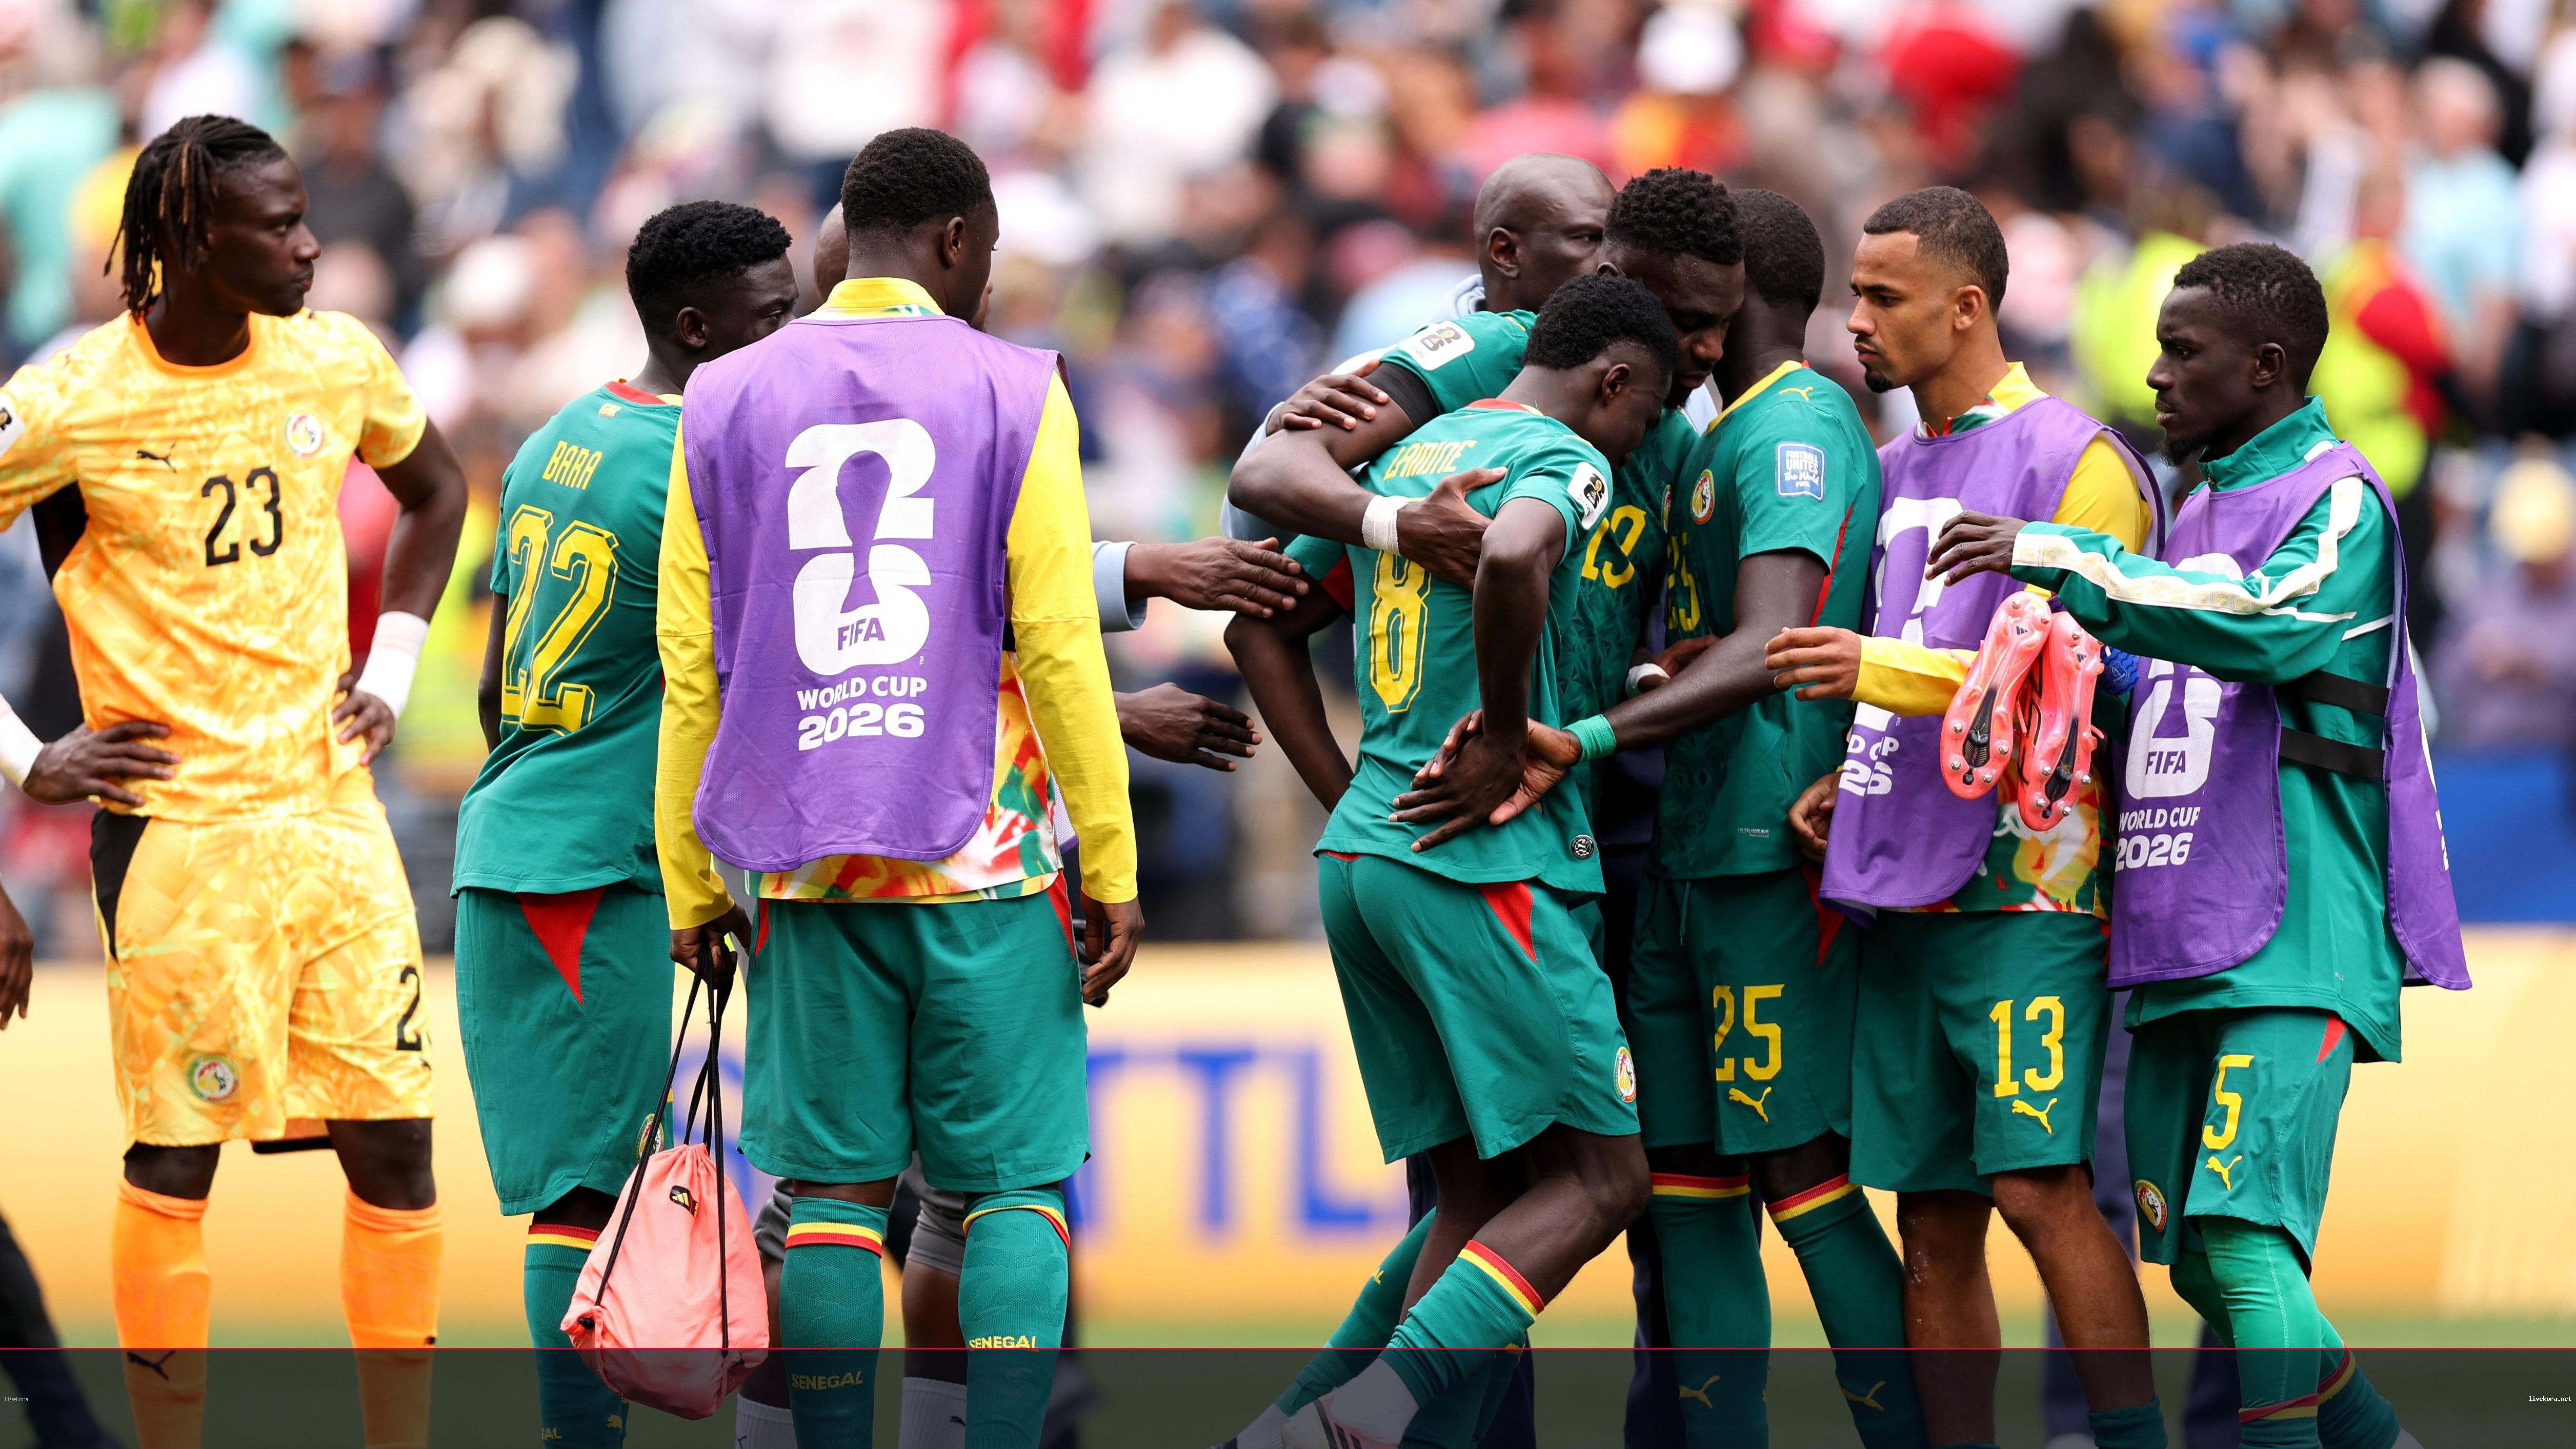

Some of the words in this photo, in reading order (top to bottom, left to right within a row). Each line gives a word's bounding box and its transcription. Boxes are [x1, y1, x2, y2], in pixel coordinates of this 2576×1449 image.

[542, 440, 603, 490] BARA
[1786, 450, 1818, 464] FOOTBALL
[1786, 458, 1818, 475] UNITES
[1784, 470, 1798, 481] the
[1799, 470, 1819, 486] World
[201, 466, 283, 567] 23
[501, 504, 620, 736] 22
[837, 617, 886, 651] FIFA
[1369, 523, 1432, 714] 8
[796, 677, 867, 711] WORLD
[872, 676, 928, 697] CUP
[798, 702, 925, 751] 2026
[1838, 759, 1893, 796] 26
[2145, 750, 2186, 776] FIFA
[2119, 809, 2168, 833] WORLD
[2169, 806, 2201, 828] CUP
[2115, 832, 2194, 873] 2026
[396, 965, 422, 1052] 2
[1713, 983, 1785, 1081] 25
[1989, 995, 2064, 1098] 13
[2202, 1054, 2255, 1150] 5
[969, 1335, 1039, 1352] SENEGAL
[791, 1370, 863, 1391] SENEGAL
